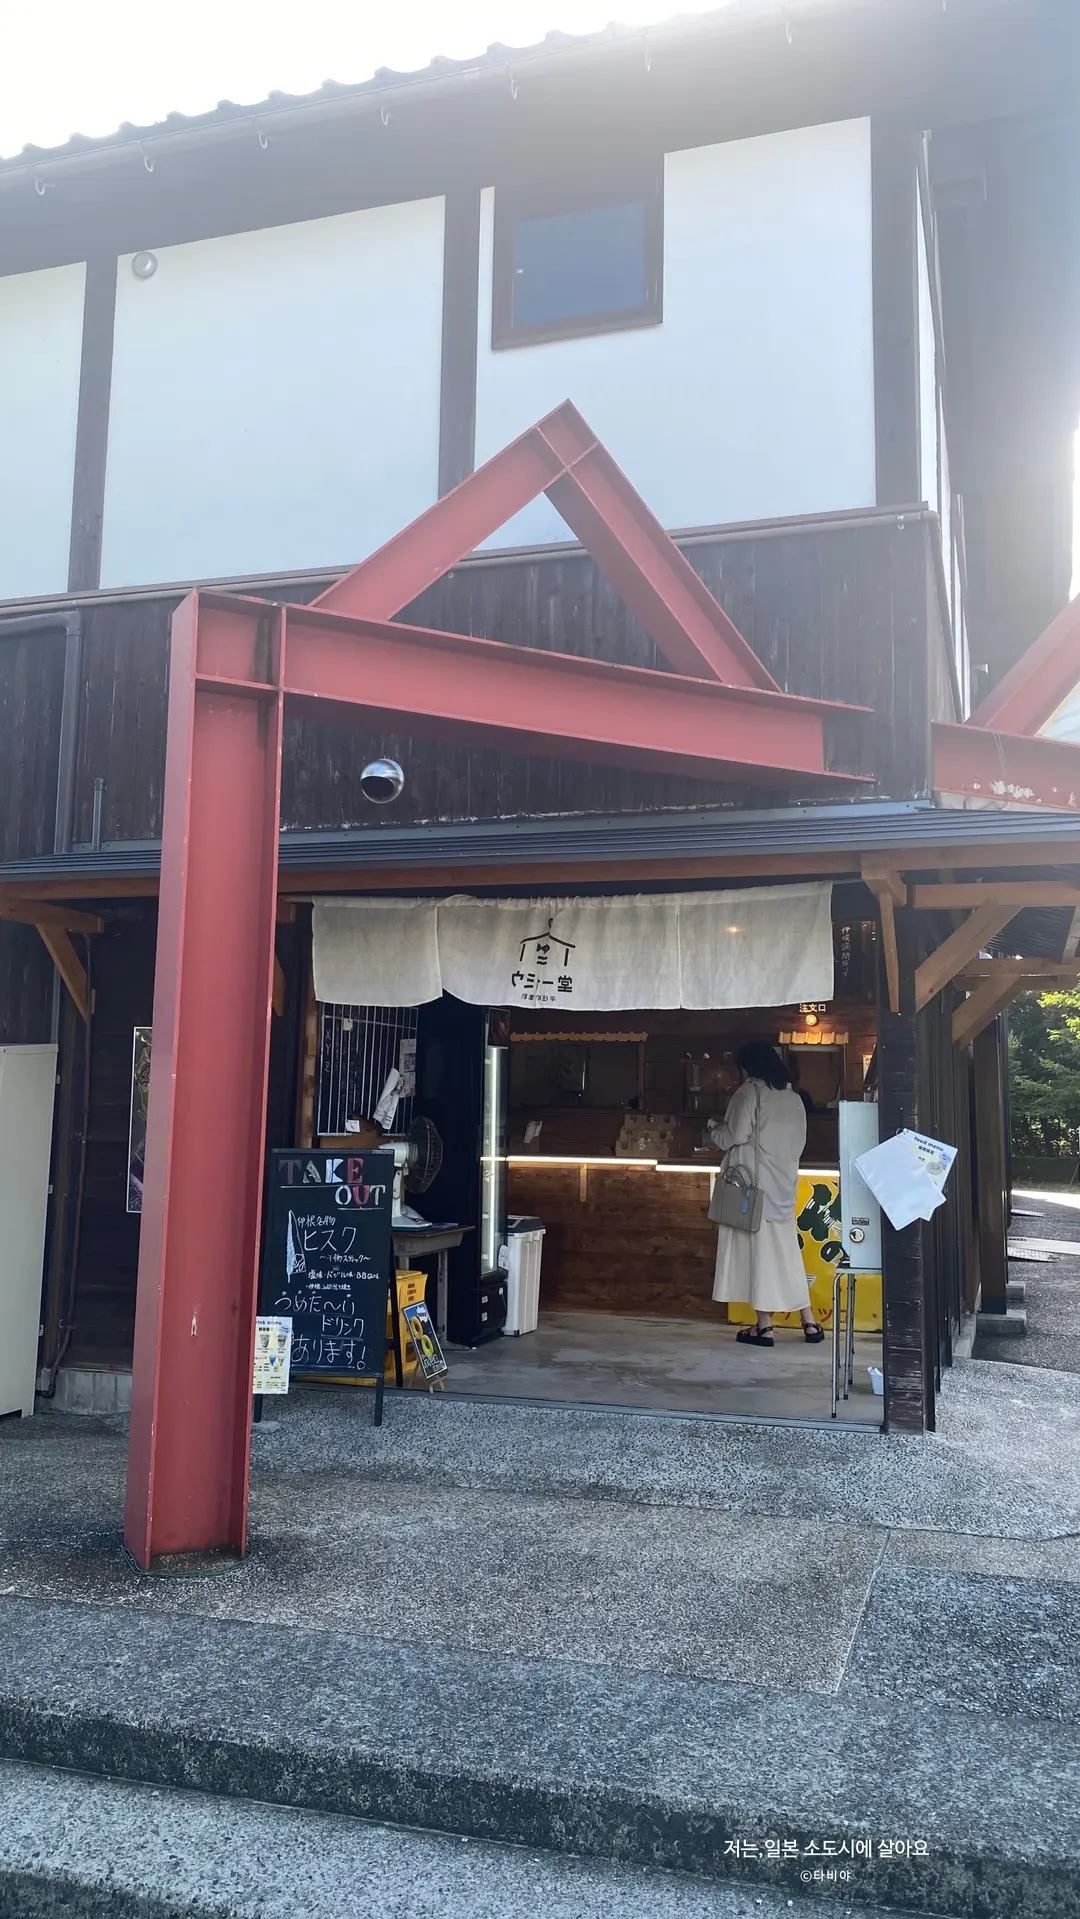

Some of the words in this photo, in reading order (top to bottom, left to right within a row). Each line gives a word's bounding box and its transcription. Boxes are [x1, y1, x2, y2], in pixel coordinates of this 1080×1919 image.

[799, 1003, 826, 1013] 注文口
[914, 1136, 927, 1145] food
[927, 1142, 944, 1152] menu
[278, 1157, 365, 1185] TAKE
[335, 1185, 386, 1206] OUT
[321, 1314, 364, 1337] ドリンク
